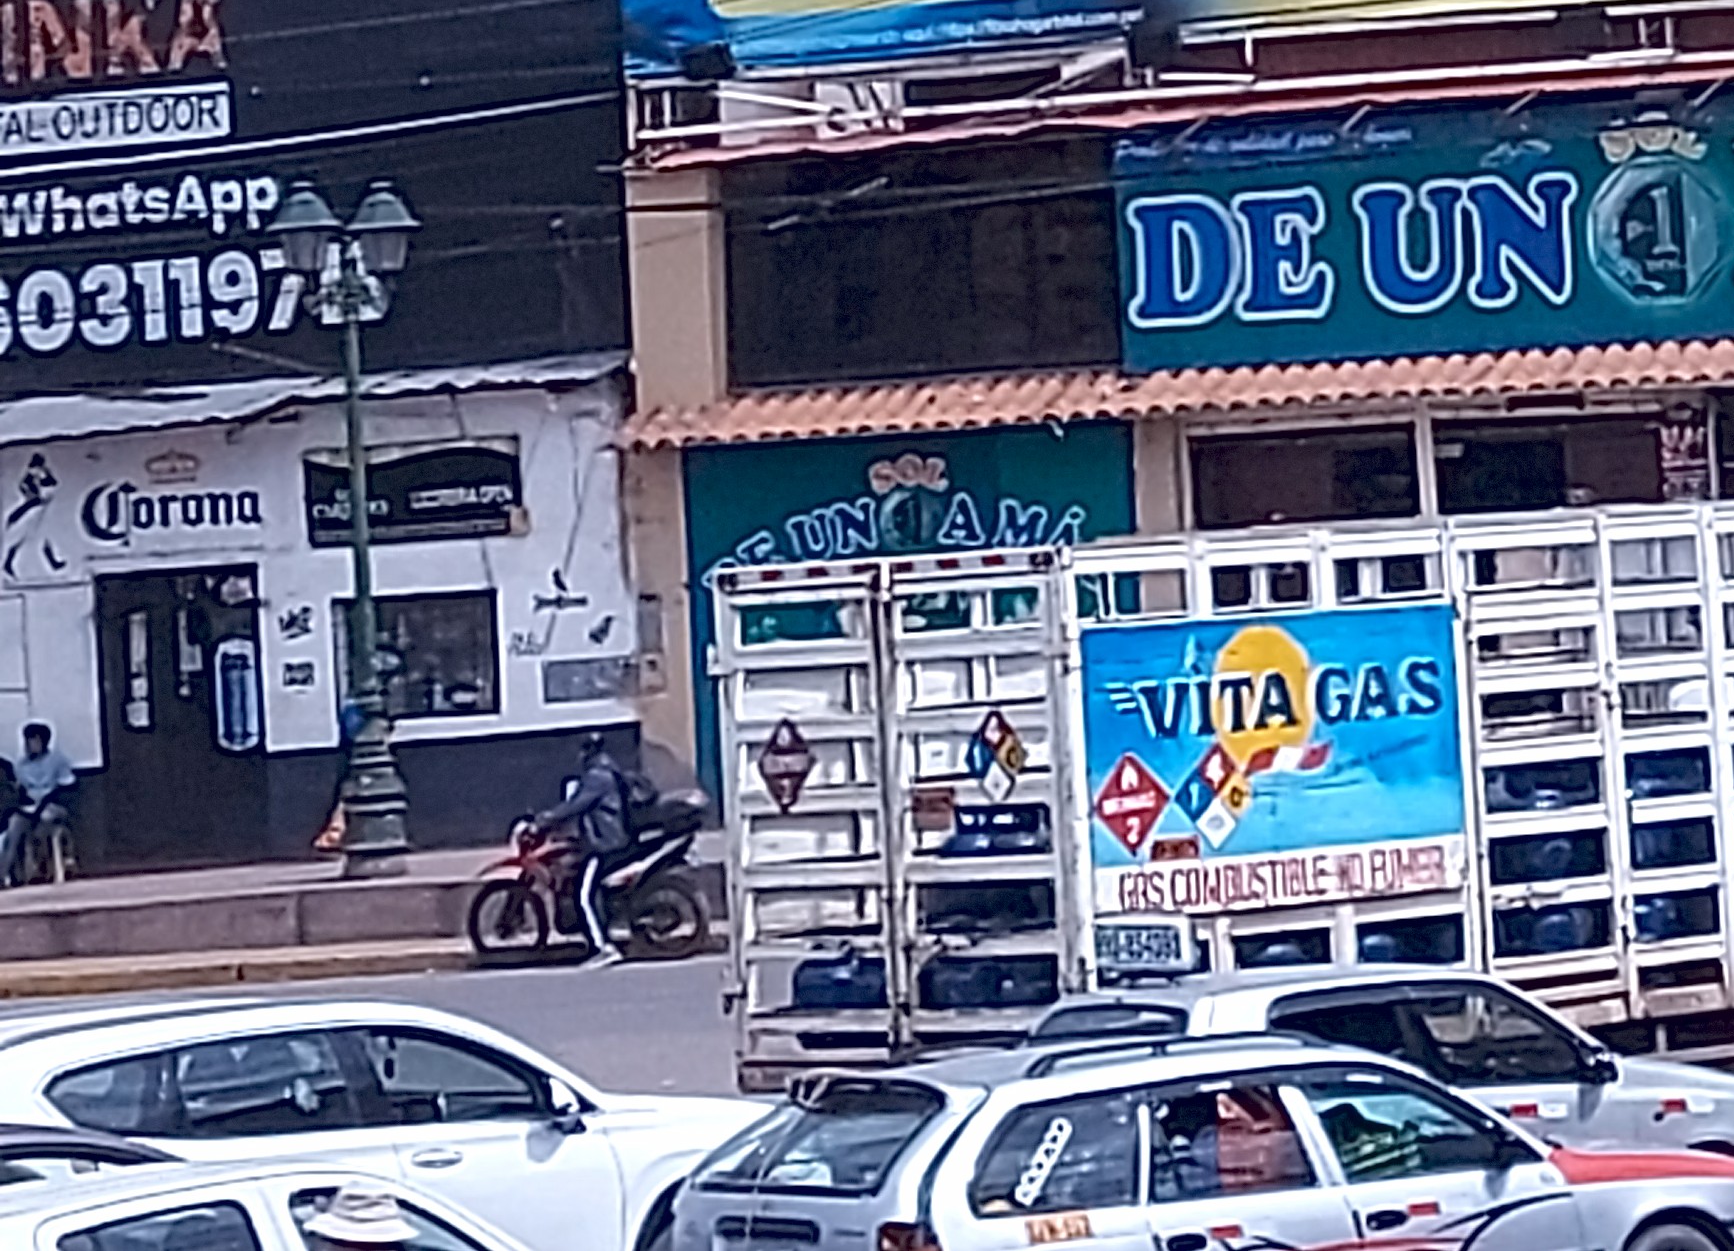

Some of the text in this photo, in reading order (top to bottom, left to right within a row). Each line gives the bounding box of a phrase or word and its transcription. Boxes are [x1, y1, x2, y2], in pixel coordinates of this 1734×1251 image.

[0, 175, 278, 238] WhatsApp
[1127, 186, 1335, 328] DE
[1352, 171, 1578, 314] UN
[0, 241, 388, 354] 031197
[81, 481, 263, 547] Corona
[785, 497, 878, 560] UN
[937, 492, 985, 546] A
[1133, 656, 1446, 738] VITA GAS
